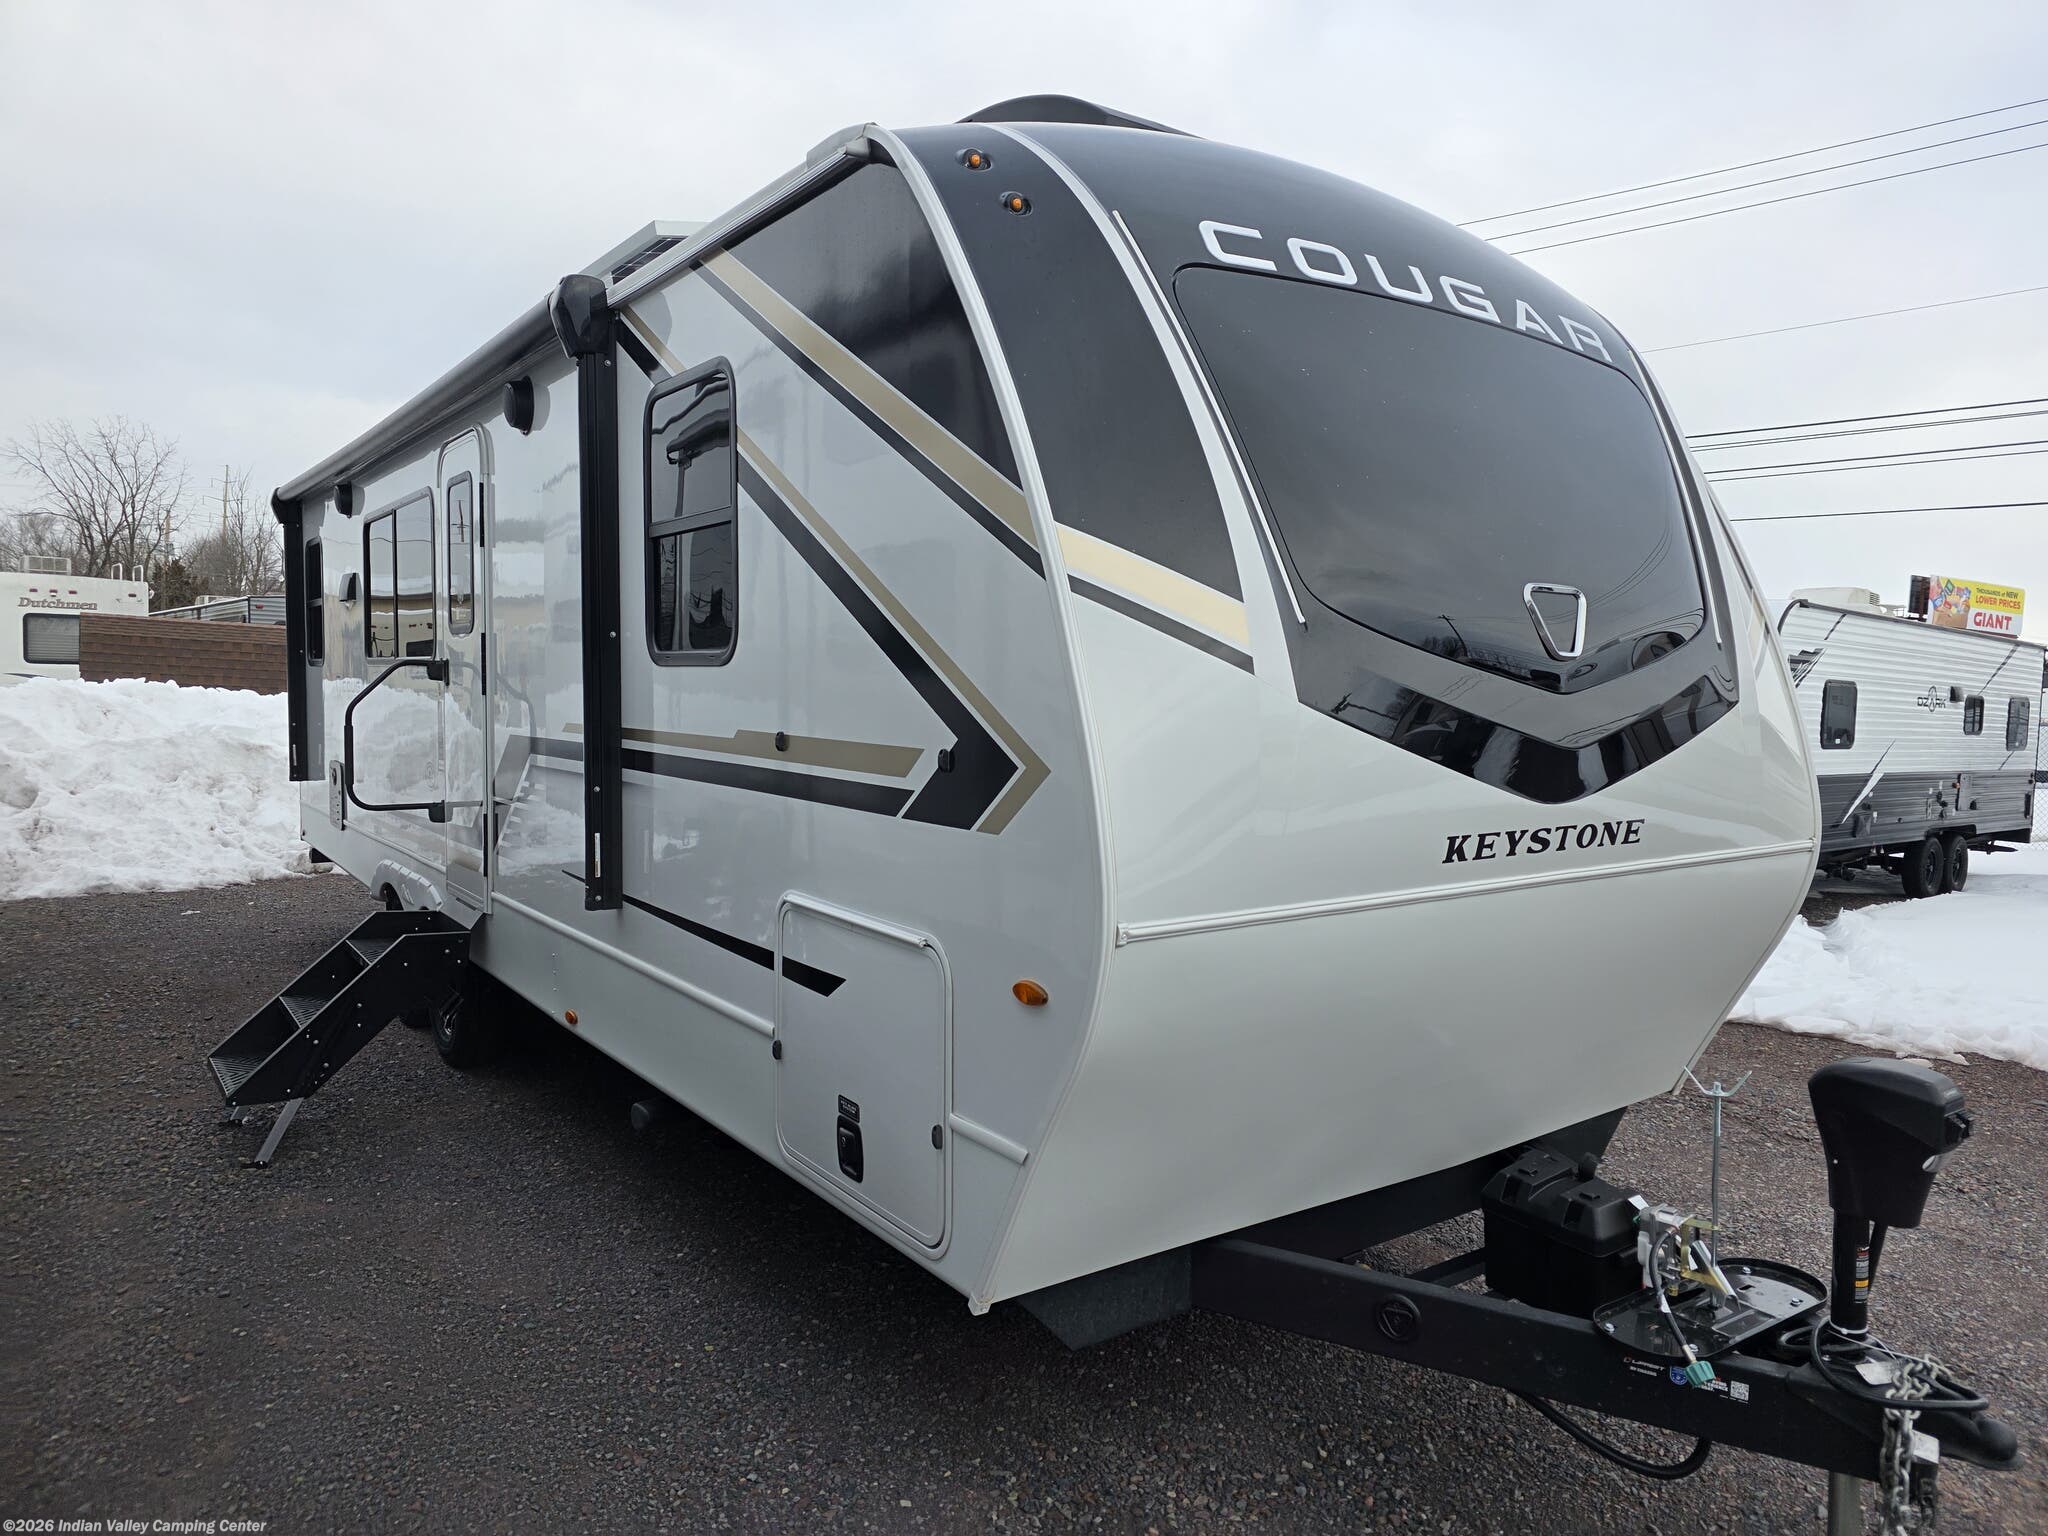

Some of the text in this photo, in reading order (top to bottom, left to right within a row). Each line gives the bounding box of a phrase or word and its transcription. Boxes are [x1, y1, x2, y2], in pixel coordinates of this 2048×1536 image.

[1198, 220, 1614, 362] COUGAR
[18, 597, 98, 610] Dutchmen
[1976, 595, 2021, 610] LOWER PRICES
[2006, 591, 2019, 599] NEW
[1973, 612, 2012, 630] GIANT
[1917, 690, 1946, 711] OZARK
[1441, 818, 1645, 864] KEYSTONE
